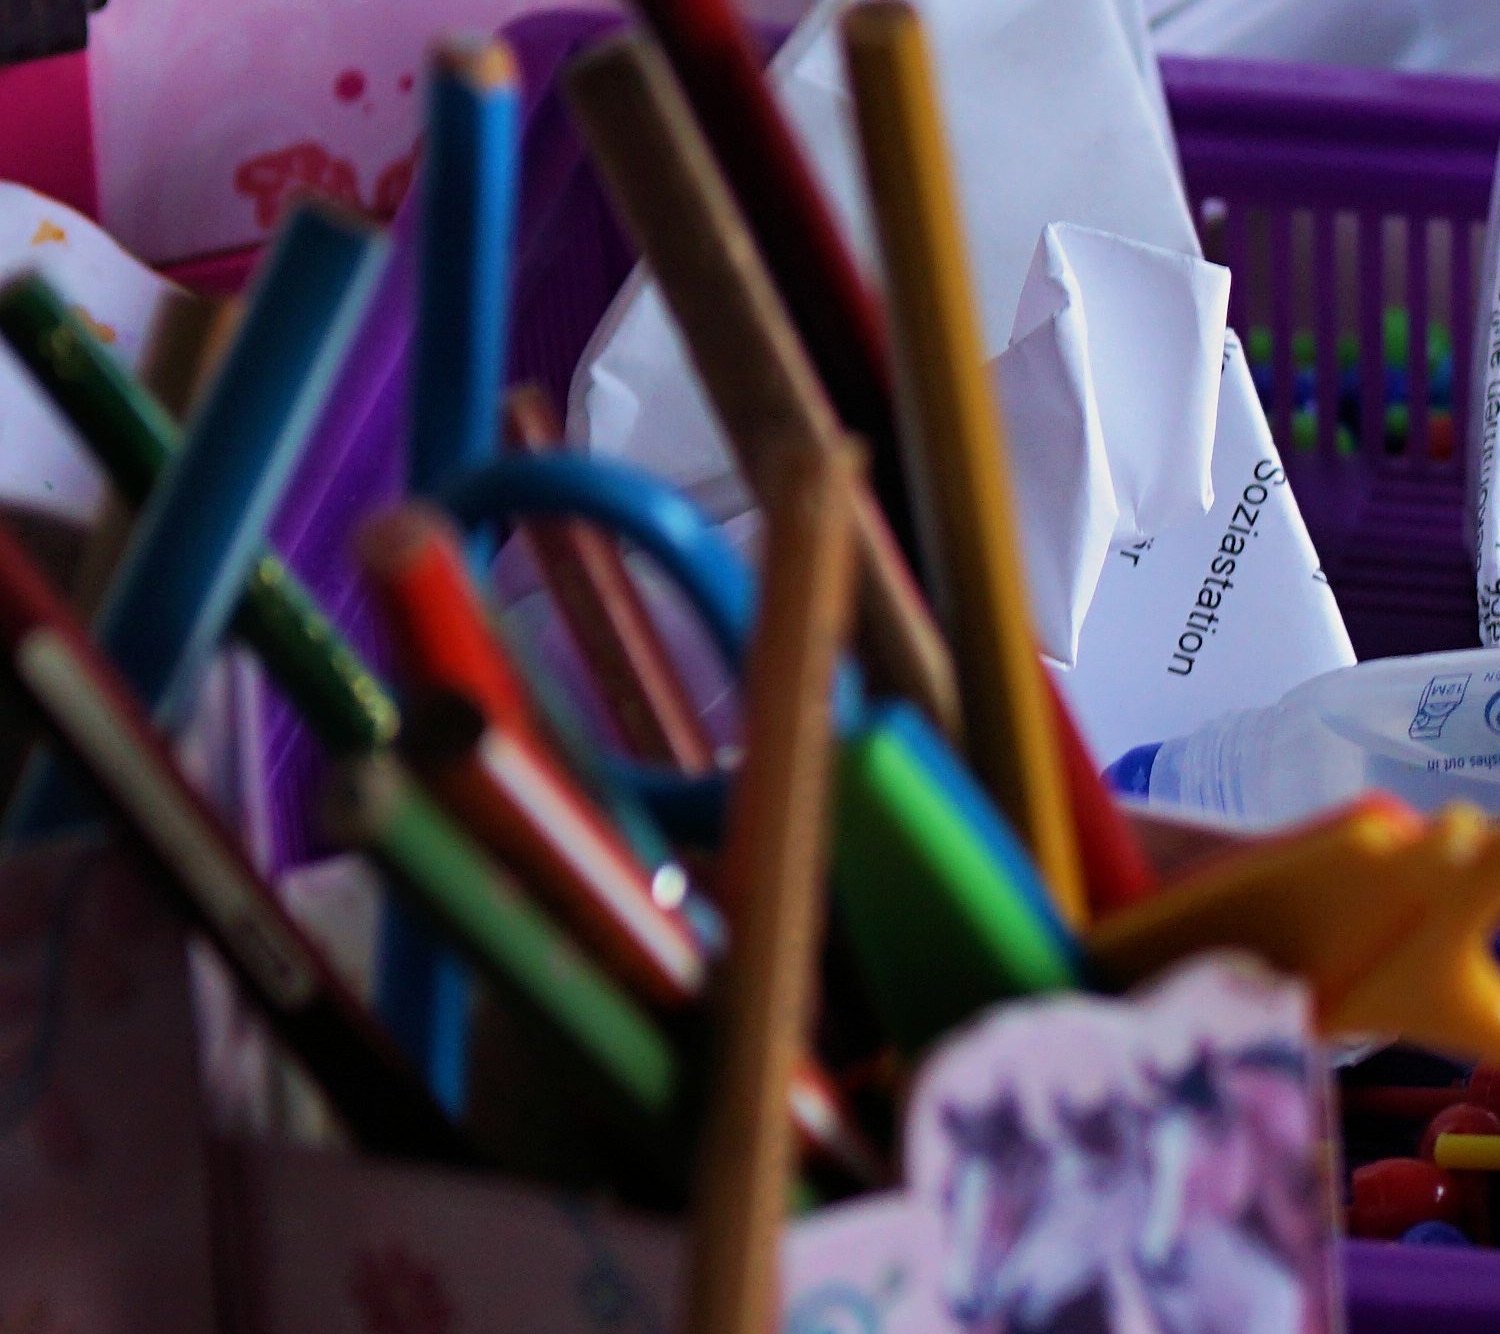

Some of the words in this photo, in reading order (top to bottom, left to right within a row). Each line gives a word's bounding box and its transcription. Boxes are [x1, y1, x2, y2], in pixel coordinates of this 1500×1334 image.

[1168, 459, 1286, 677] Soziastation
[1426, 758, 1445, 774] in
[1447, 757, 1466, 772] out
